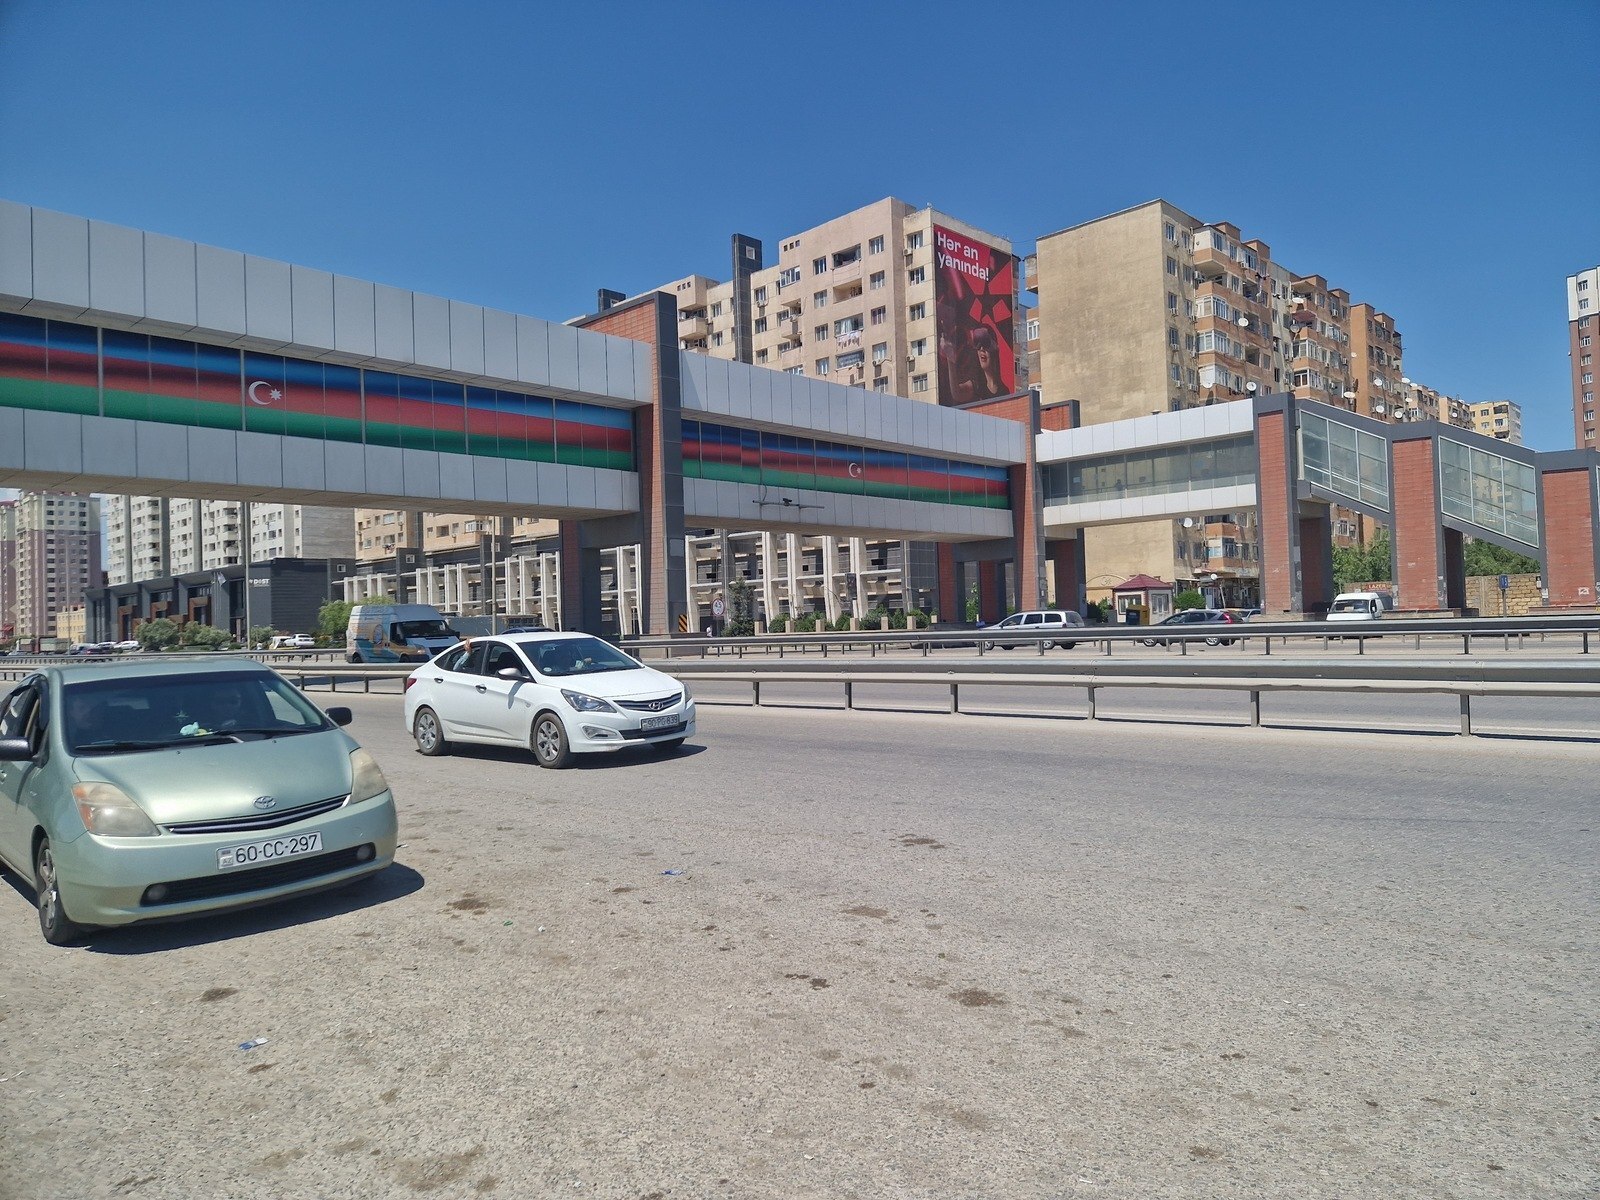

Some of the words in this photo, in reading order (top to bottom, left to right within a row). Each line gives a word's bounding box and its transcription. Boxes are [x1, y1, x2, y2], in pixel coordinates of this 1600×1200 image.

[937, 231, 961, 252] Hər
[963, 245, 978, 260] an
[937, 251, 989, 281] yanında!
[235, 834, 318, 864] 60-CC-297
